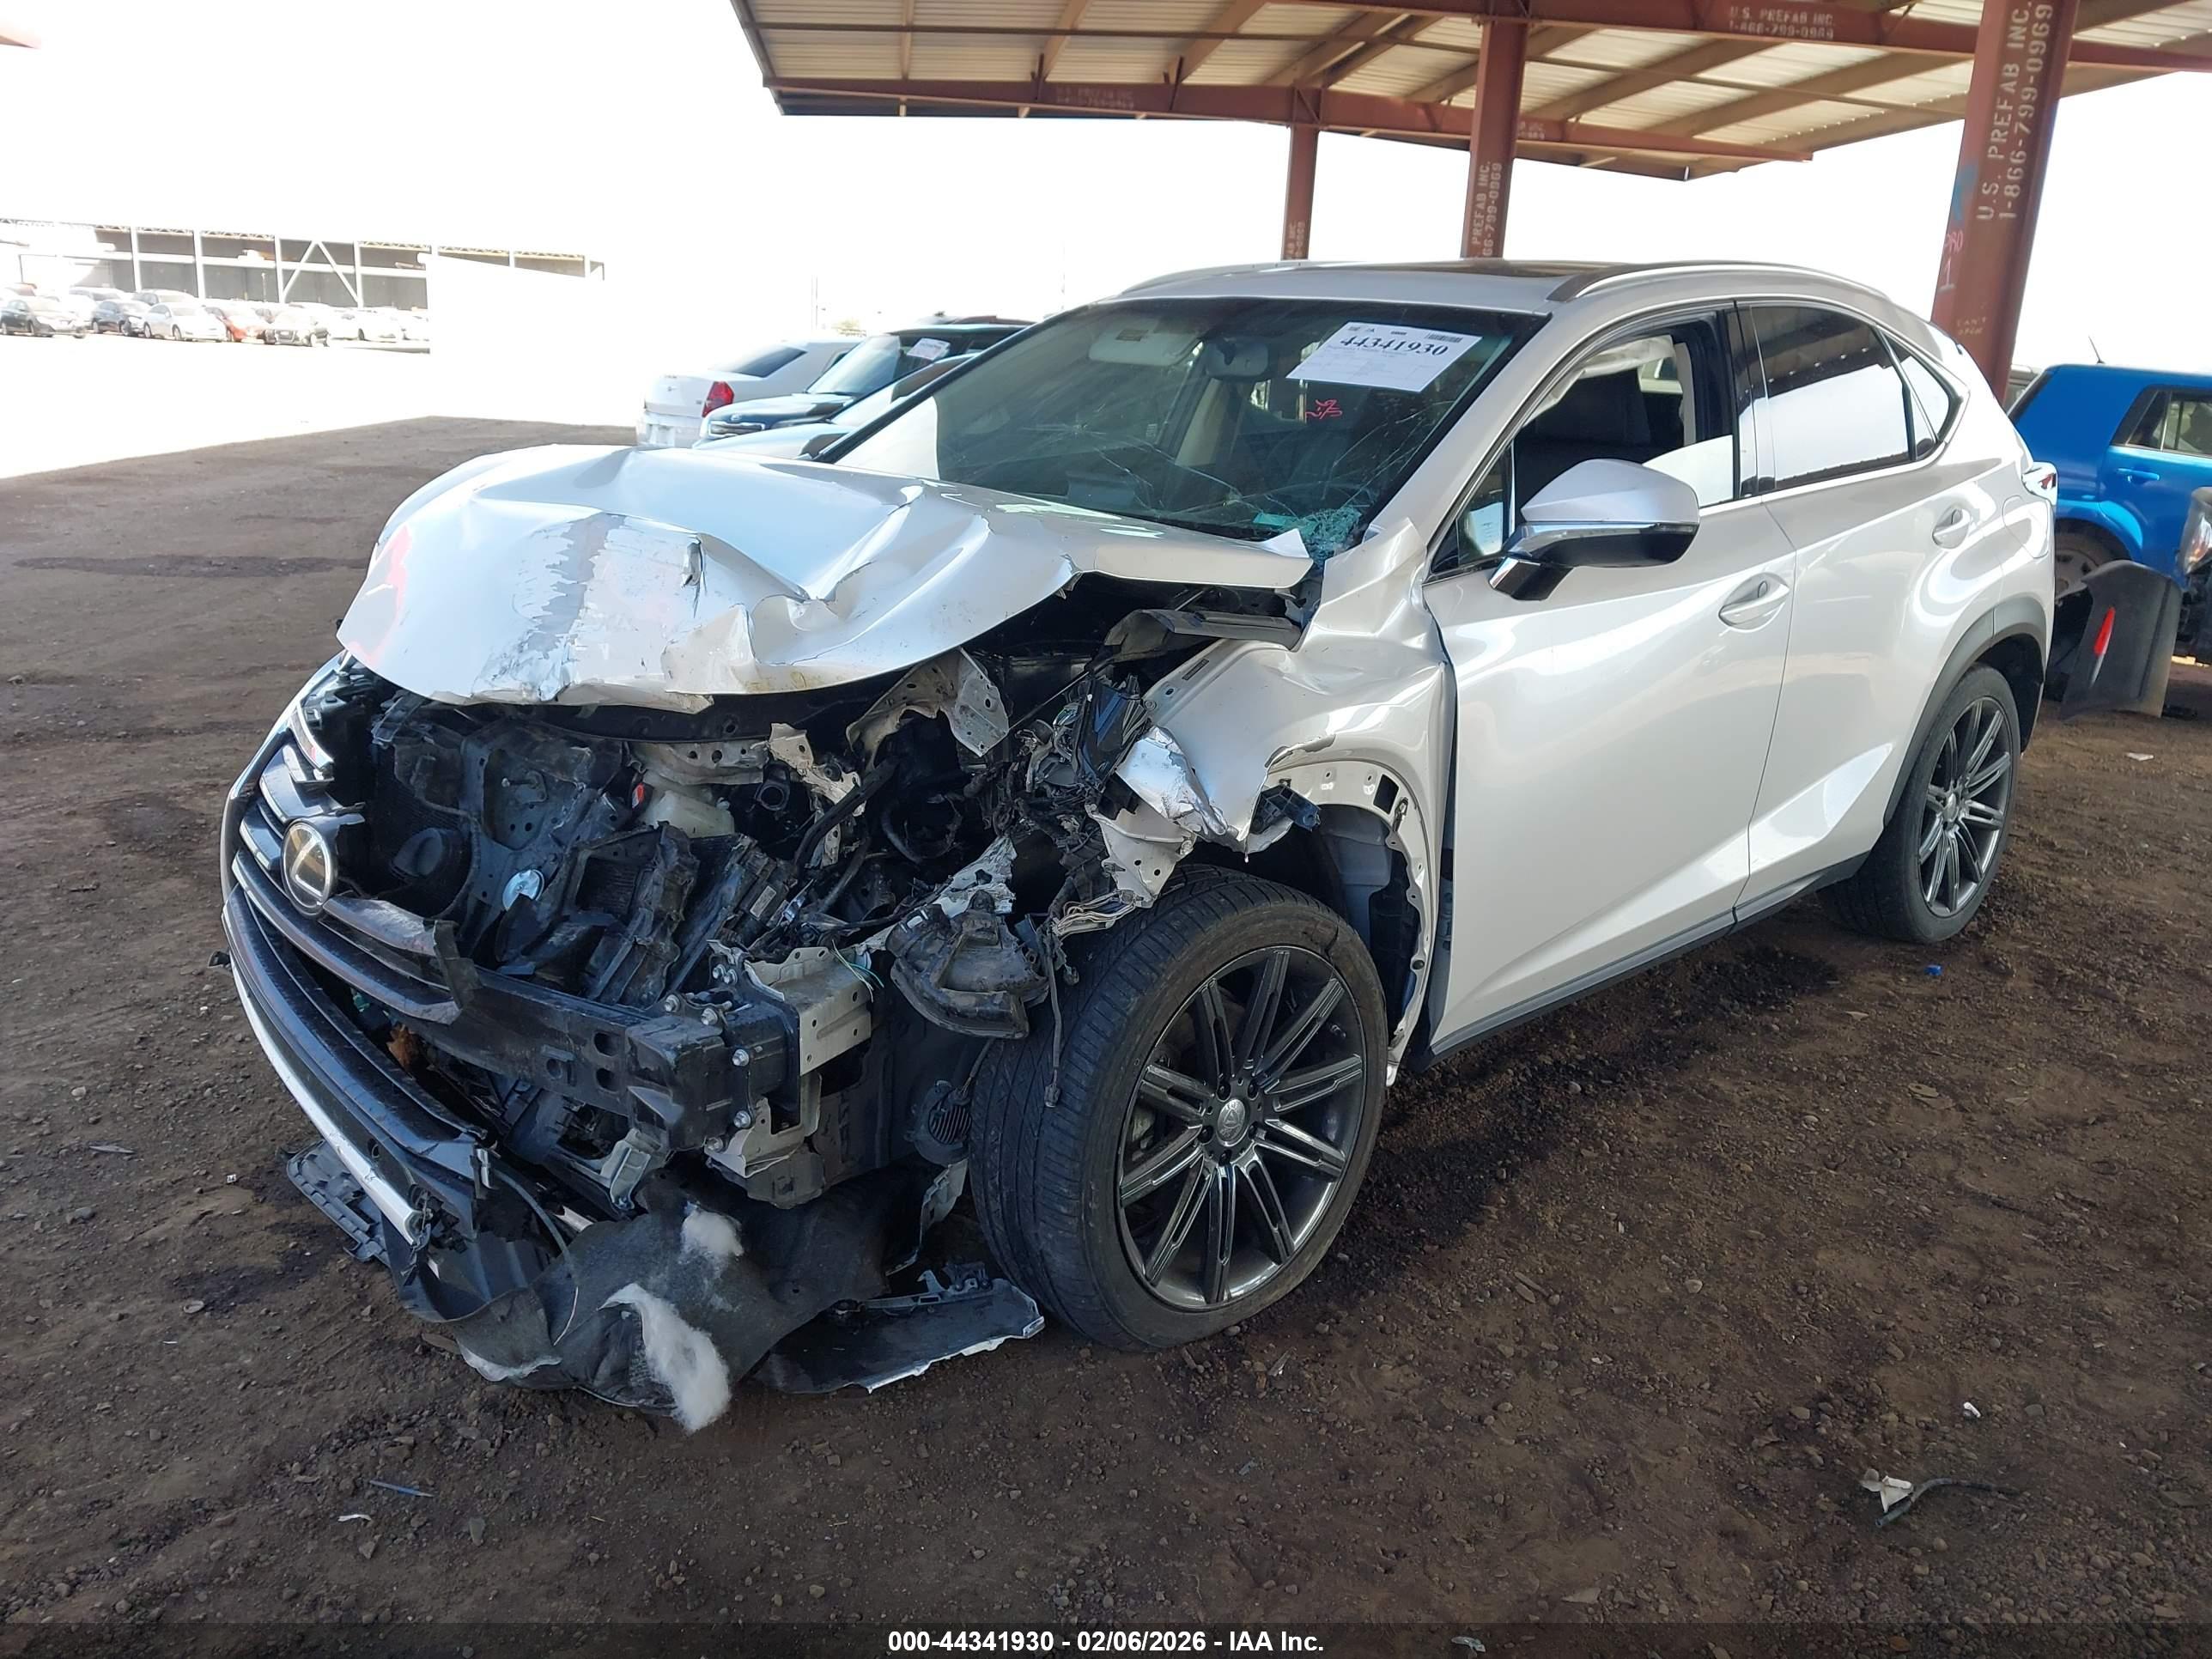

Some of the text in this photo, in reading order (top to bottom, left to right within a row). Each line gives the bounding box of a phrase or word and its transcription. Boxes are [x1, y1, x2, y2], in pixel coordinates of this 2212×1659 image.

[1760, 9, 1808, 24] PREFAB
[1977, 2, 2032, 220] U.S. PREFAB INC.
[1999, 4, 2053, 219] 1-866-799-0969
[1471, 193, 1486, 245] PREFAB
[1340, 335, 1449, 356] 44341930
